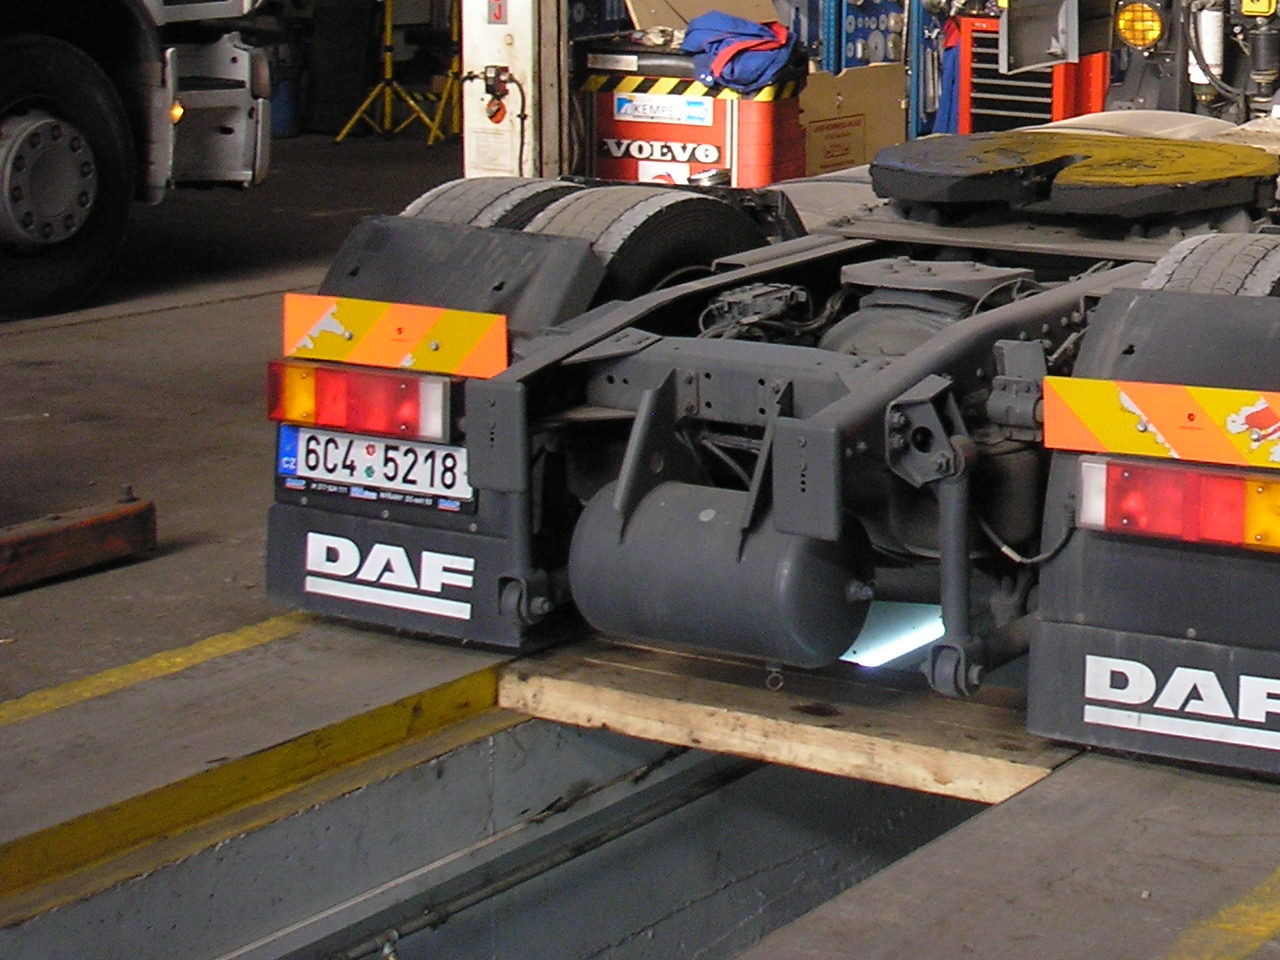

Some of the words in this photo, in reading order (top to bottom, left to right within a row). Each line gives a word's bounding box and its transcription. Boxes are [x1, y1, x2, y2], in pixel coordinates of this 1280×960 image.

[632, 103, 681, 116] KEMPE
[603, 139, 719, 163] VOLVO
[282, 456, 297, 469] CZ
[305, 434, 356, 477] 6C4
[383, 444, 457, 489] 5218
[306, 531, 475, 593] DAF
